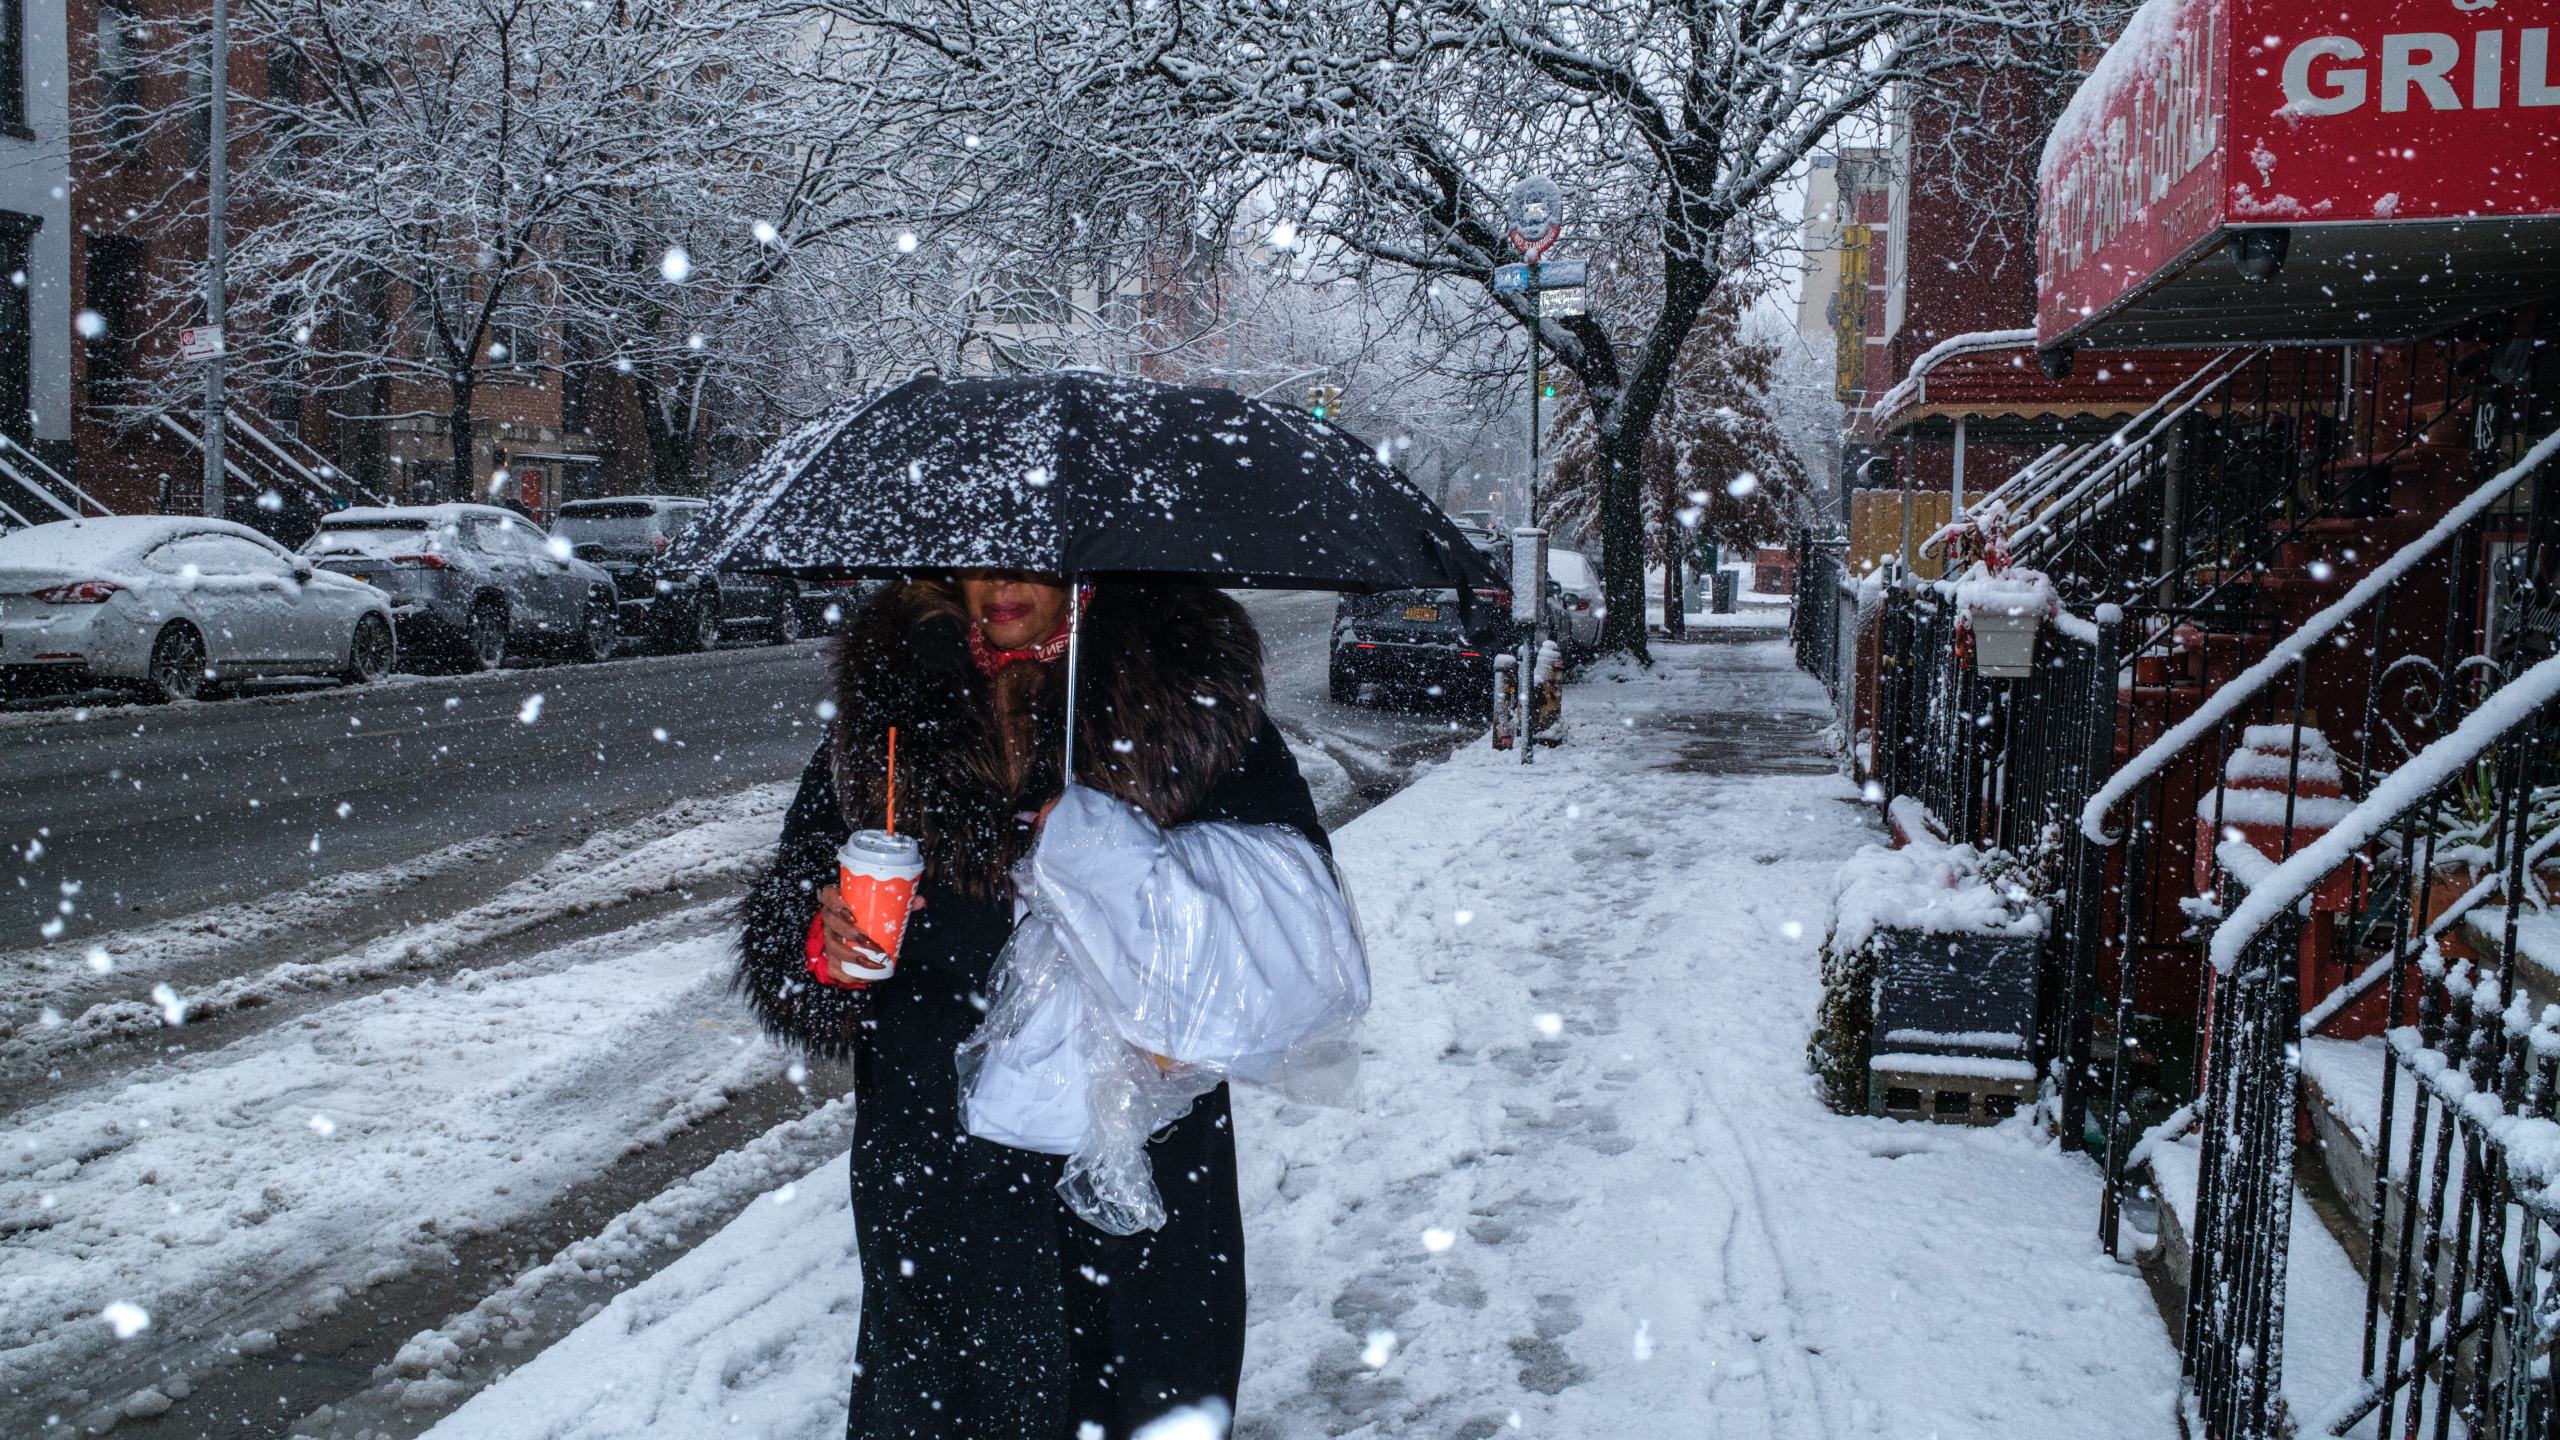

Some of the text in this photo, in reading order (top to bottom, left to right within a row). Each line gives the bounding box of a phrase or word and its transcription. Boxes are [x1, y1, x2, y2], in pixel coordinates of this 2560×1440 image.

[2092, 114, 2127, 255] BAR
[2149, 9, 2217, 206] GRILL
[2280, 27, 2560, 116] GRIL
